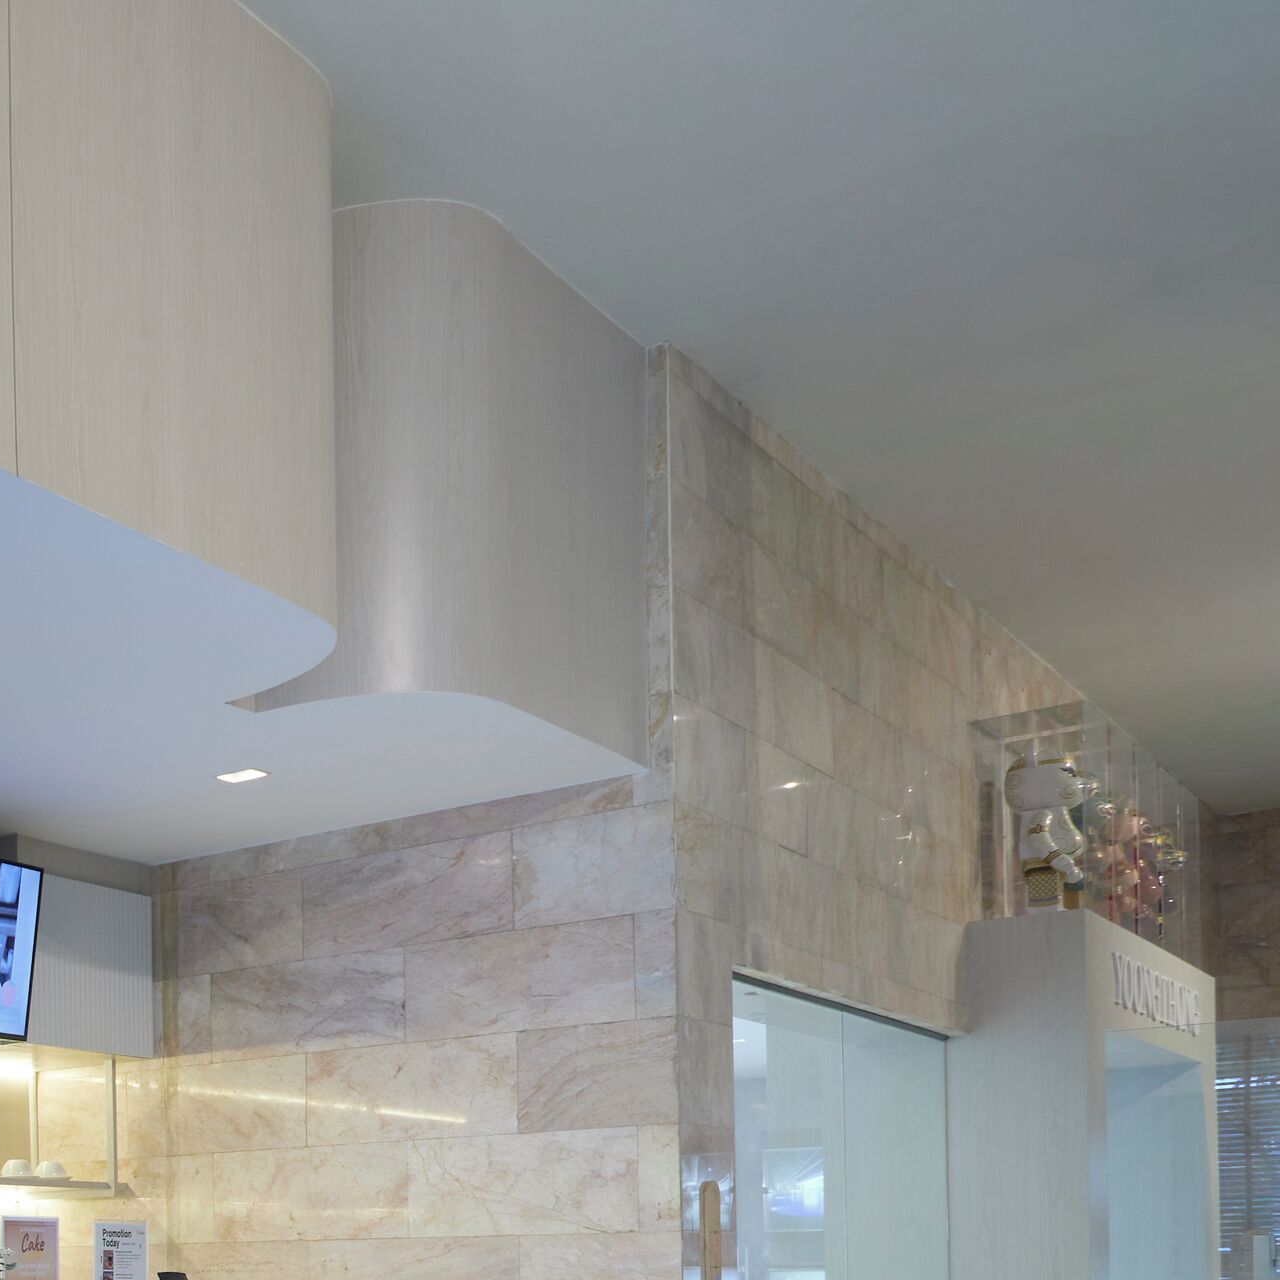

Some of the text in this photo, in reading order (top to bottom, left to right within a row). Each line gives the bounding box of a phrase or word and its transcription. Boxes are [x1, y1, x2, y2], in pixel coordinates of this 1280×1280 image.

[102, 1228, 132, 1239] Promotion
[22, 1232, 45, 1253] Cake
[102, 1238, 120, 1249] Today
